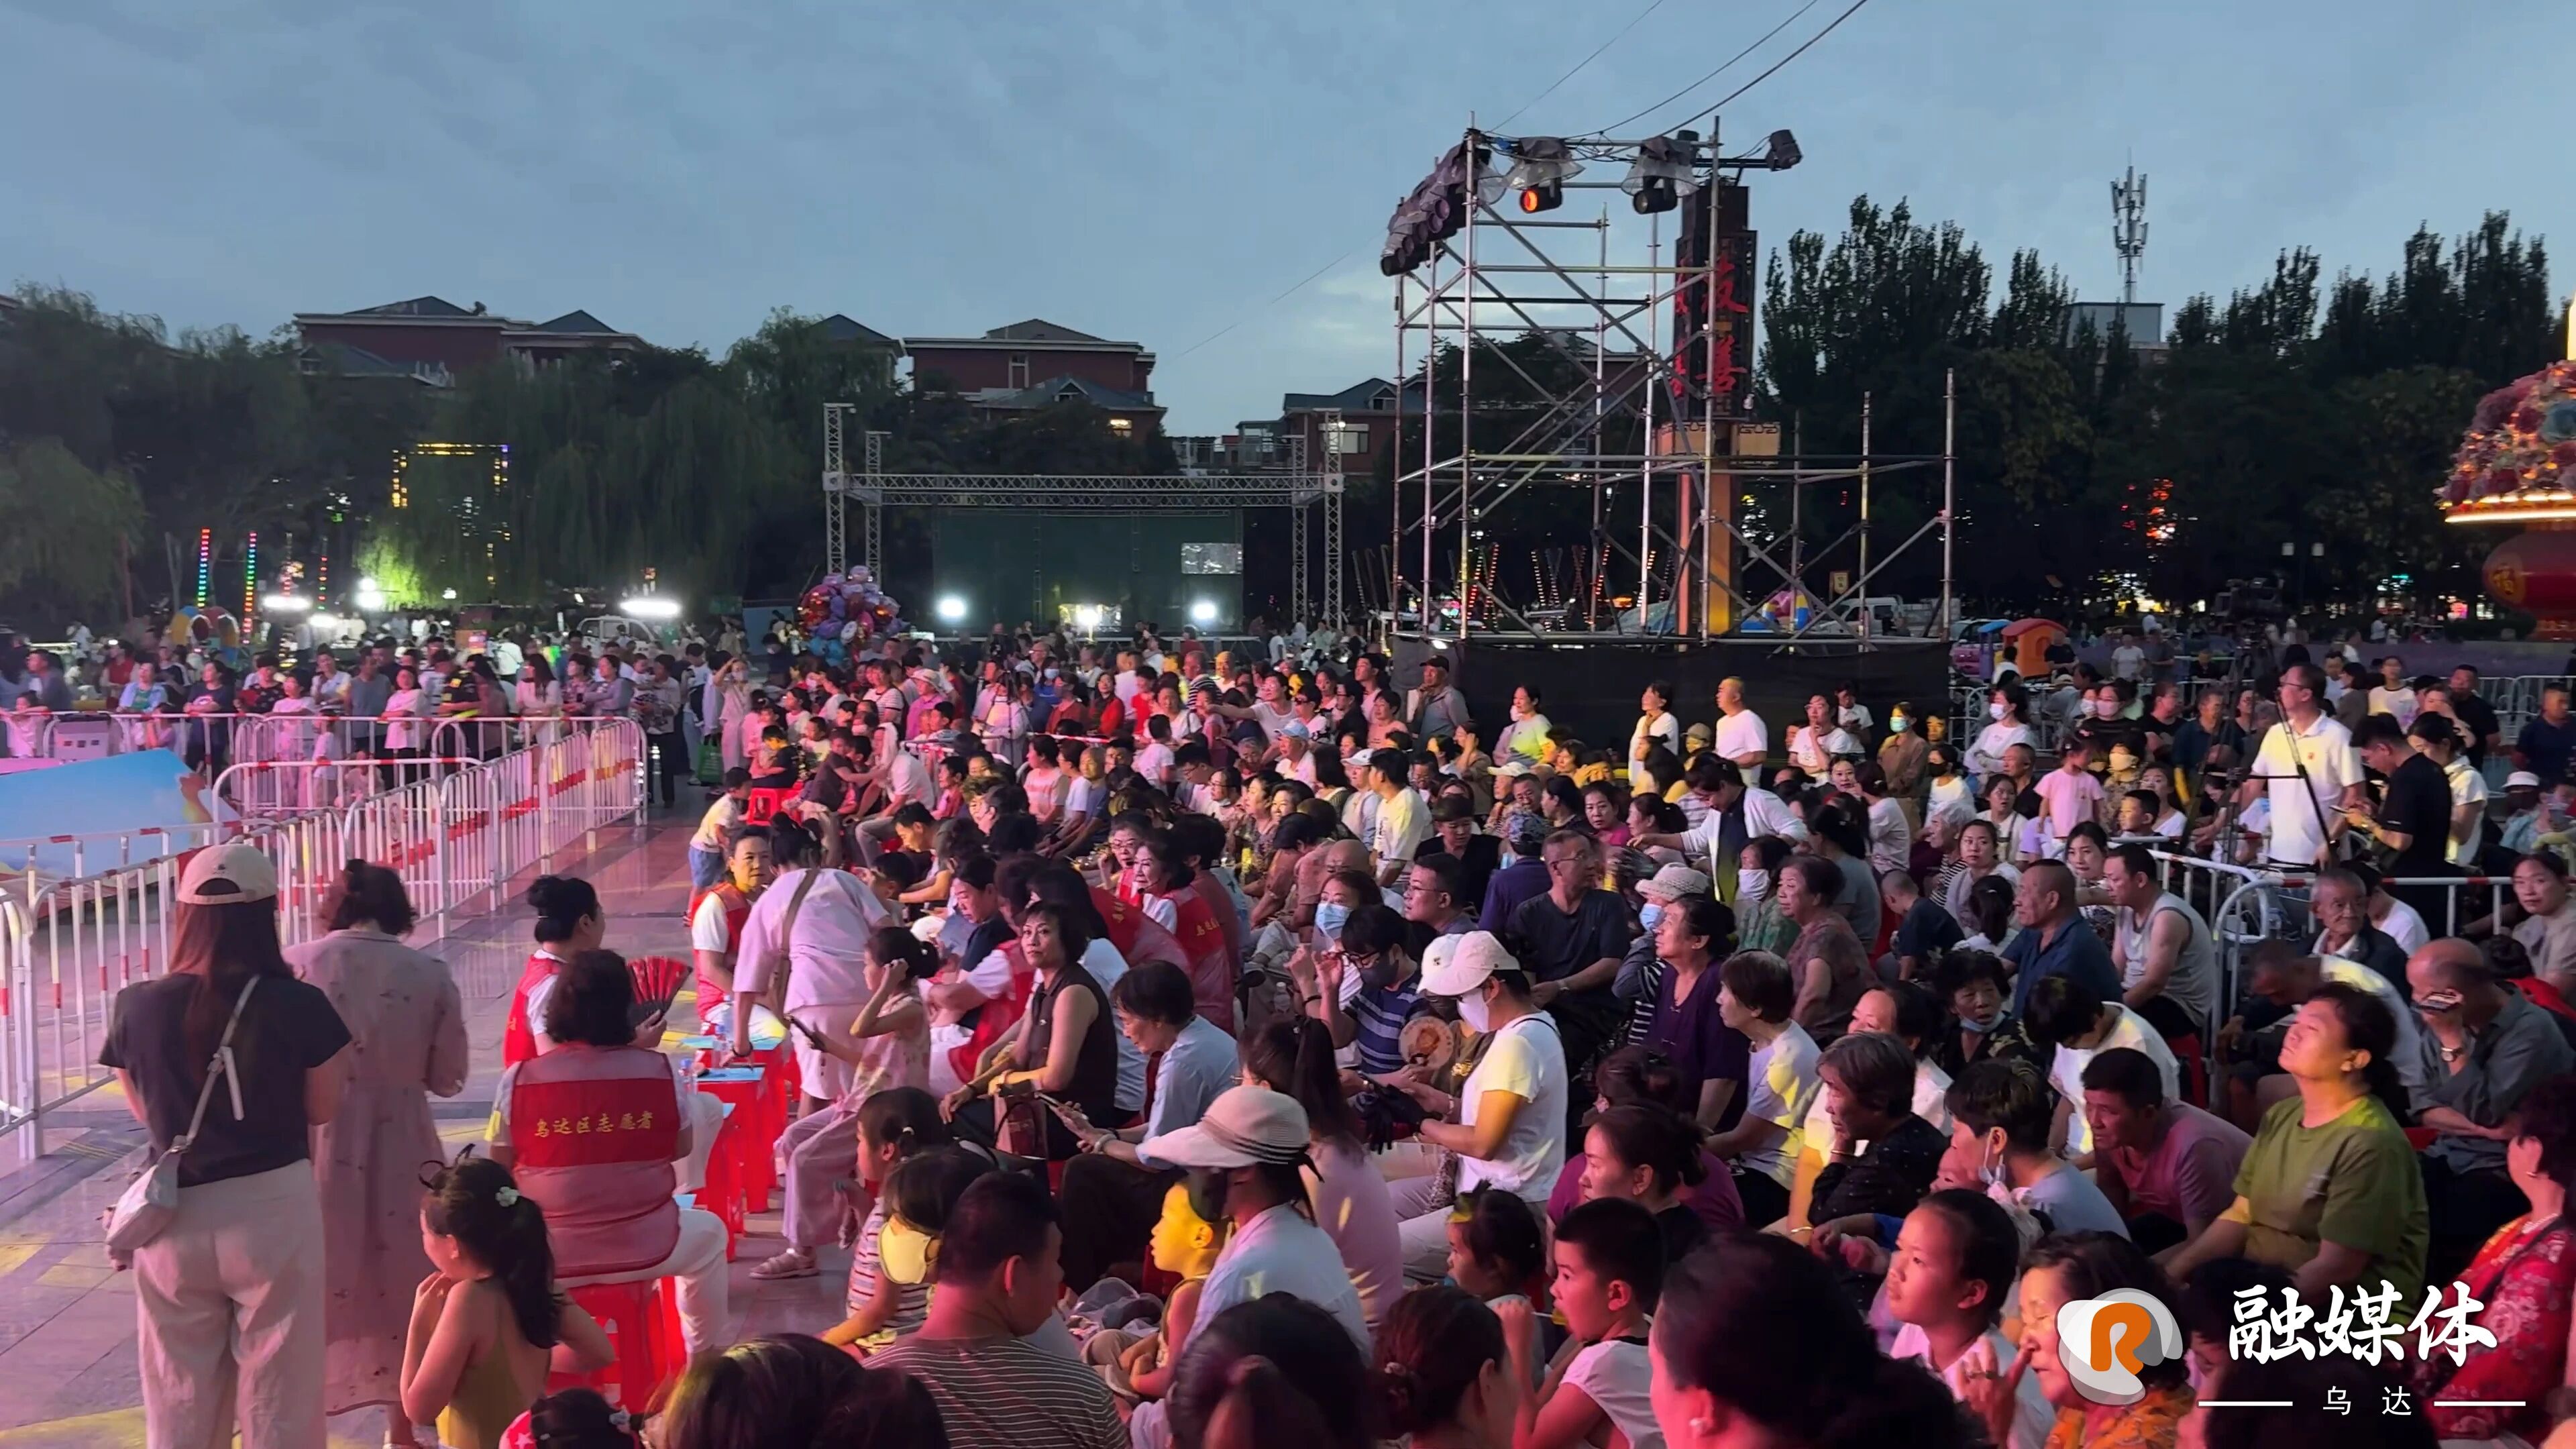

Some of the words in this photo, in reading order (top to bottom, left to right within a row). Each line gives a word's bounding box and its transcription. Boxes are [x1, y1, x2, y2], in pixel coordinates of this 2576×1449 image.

[534, 1110, 653, 1138] 乌达区志愿者
